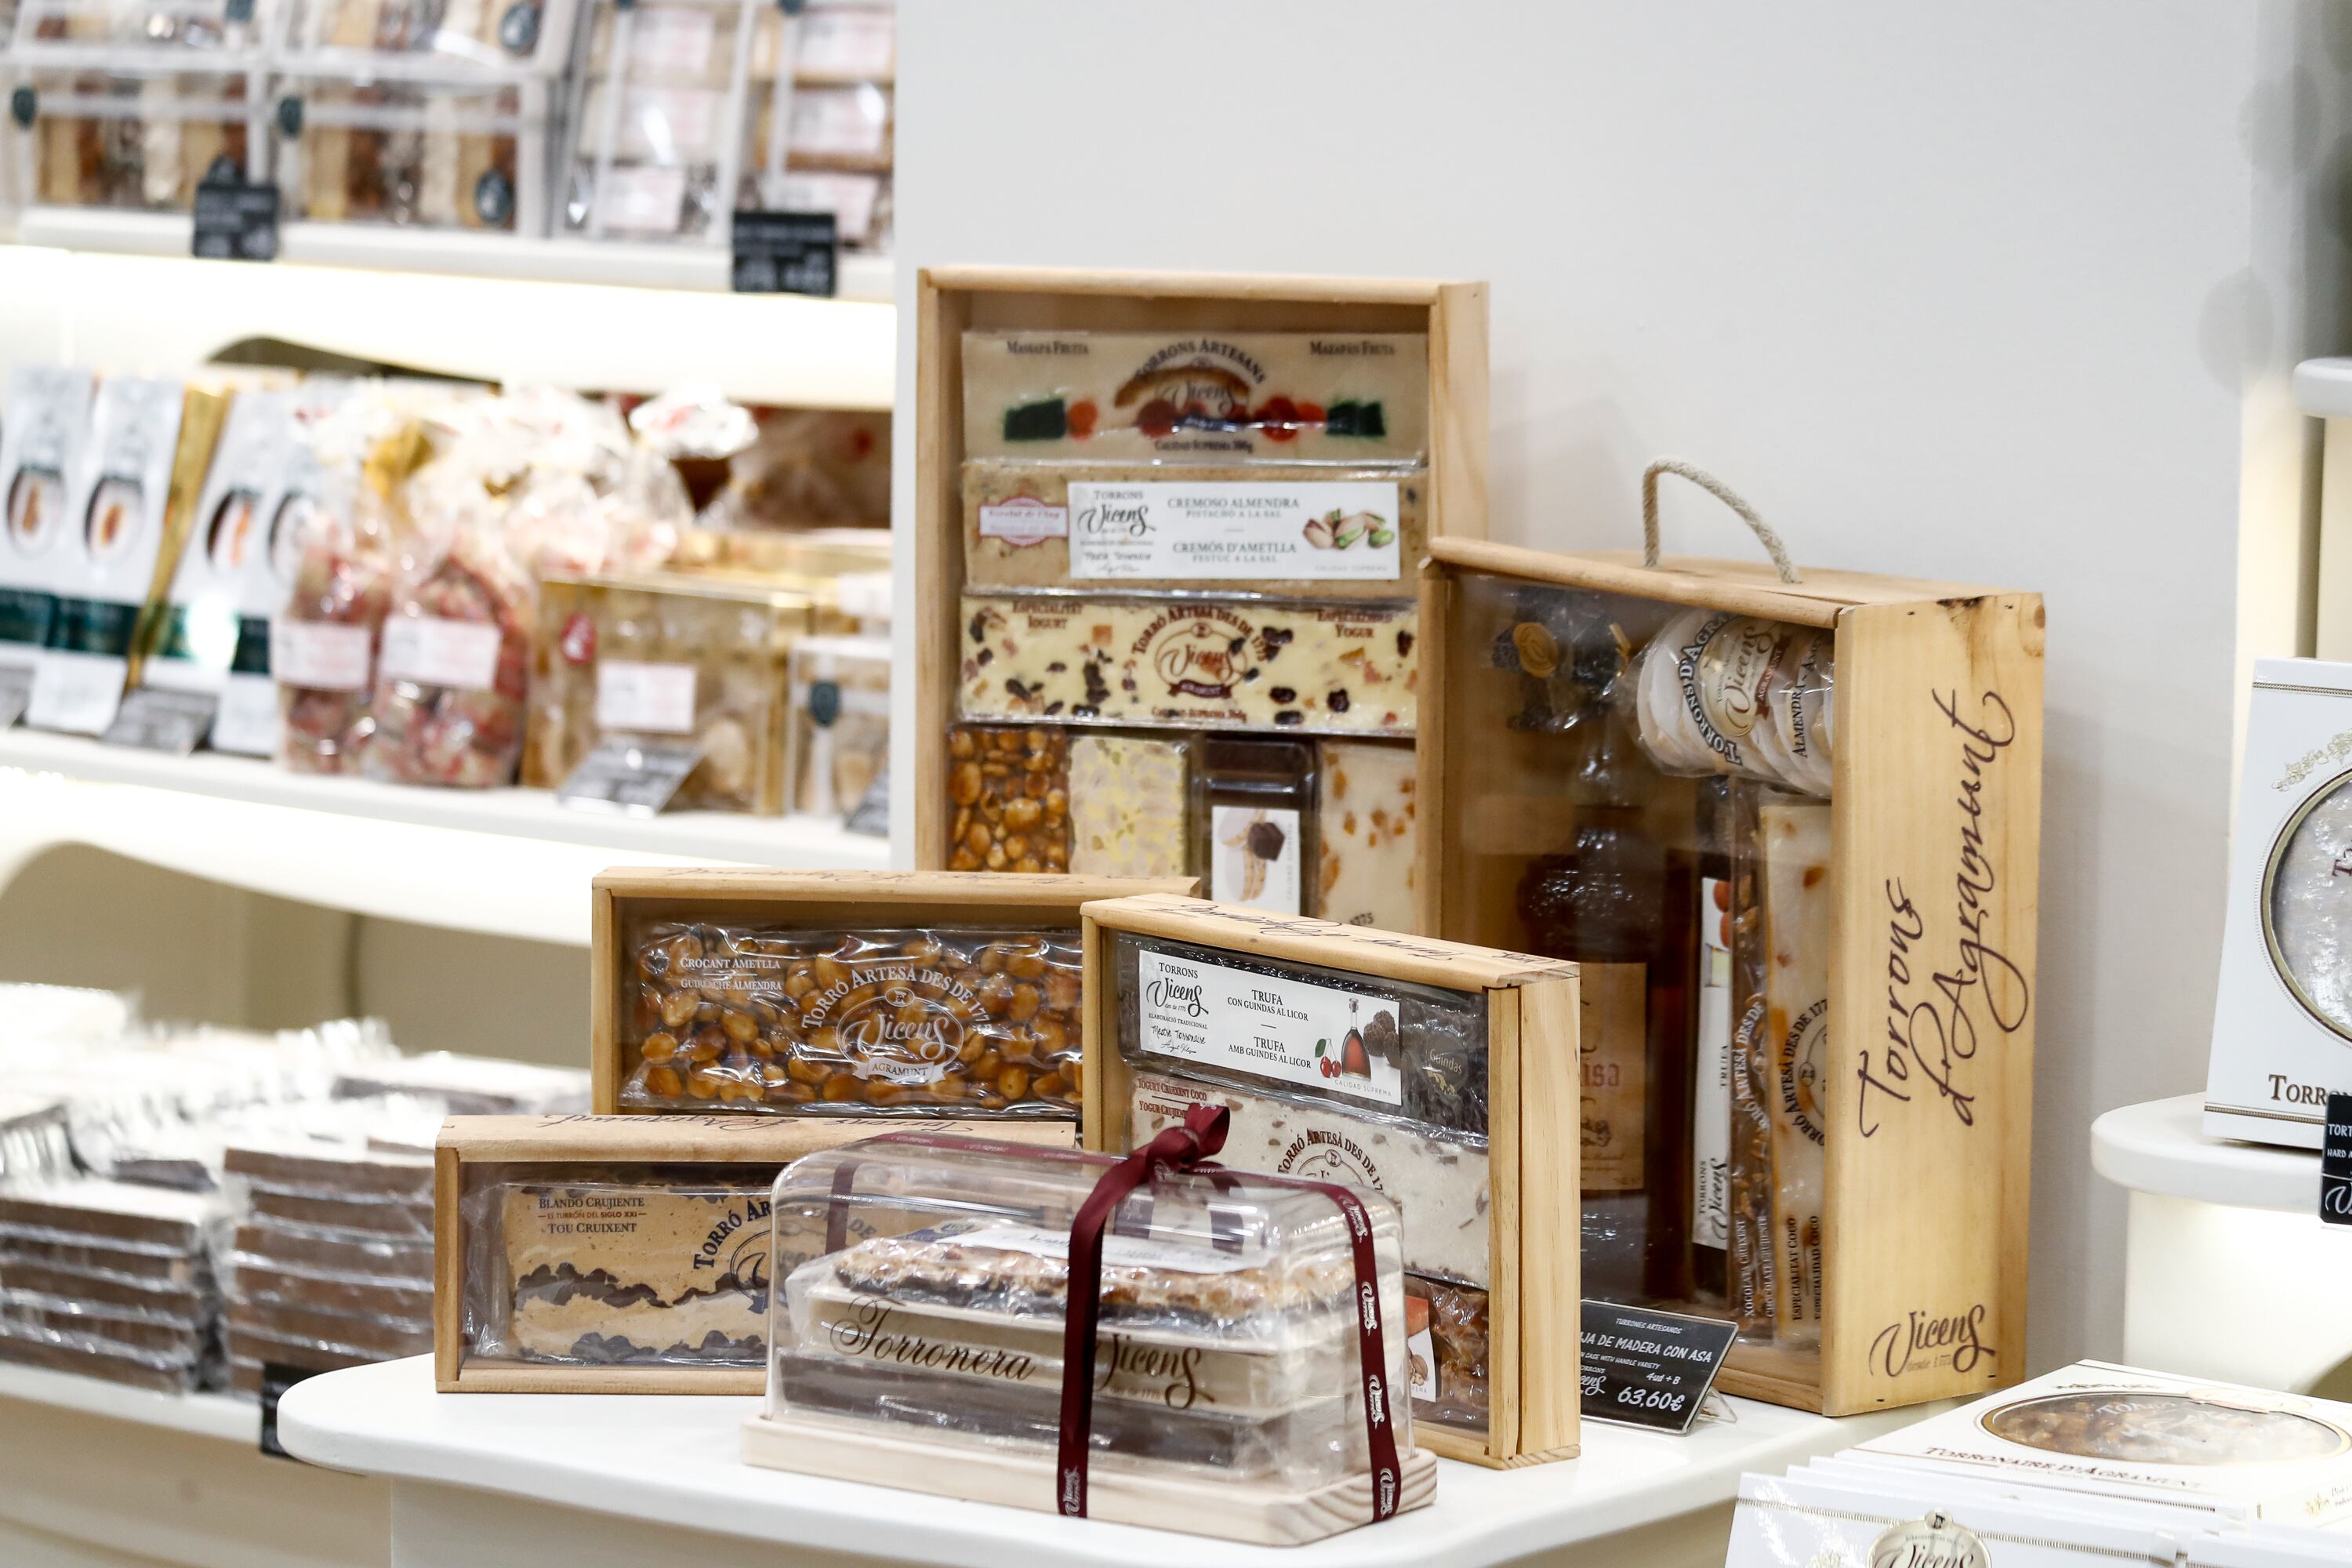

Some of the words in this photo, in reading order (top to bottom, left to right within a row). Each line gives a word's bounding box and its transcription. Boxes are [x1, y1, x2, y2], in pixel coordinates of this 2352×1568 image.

[1135, 340, 1196, 376] ORRONS
[1093, 491, 1144, 500] TORRONS
[1167, 499, 1229, 508] CREMOSO
[1230, 499, 1300, 508] ALMENDRA
[1078, 504, 1156, 537] Vicens
[1173, 541, 1225, 554] CREMÓS
[1227, 543, 1297, 553] D'AMETLLA
[1679, 612, 1730, 681] D'AGR
[1726, 624, 1778, 729] Vicens
[1683, 684, 1744, 766] TORRONS
[1791, 684, 1808, 758] ALMENDRA
[680, 957, 731, 970] CROCANT
[733, 958, 782, 969] AMETLLA
[1159, 962, 1199, 979] TORRONS
[732, 981, 782, 991] ALMENDRA
[801, 979, 850, 1029] TORRÓ
[851, 964, 916, 989] ARTESÀ
[920, 968, 953, 991] DES
[949, 982, 975, 1005] DE
[1145, 977, 1210, 1018] Vicens
[1251, 989, 1284, 1006] TRUFA
[1227, 996, 1243, 1007] CON
[1243, 1000, 1276, 1014] GUINDAS
[1276, 1007, 1287, 1017] AL
[1287, 1009, 1309, 1022] LICOR
[1809, 999, 1828, 1018] 177
[1859, 876, 1924, 1138] Torrons
[1149, 1012, 1177, 1024] ELABORACIÓ
[1177, 1018, 1209, 1030] TRADICIONAL
[1736, 1018, 1755, 1044] DES
[1795, 1013, 1812, 1032] DE
[841, 1013, 960, 1060] Vicens
[1254, 1036, 1286, 1053] TRUFA
[1784, 1032, 1801, 1057] DES
[1228, 1044, 1245, 1054] AMB
[1245, 1047, 1278, 1062] GUINDES
[1278, 1055, 1289, 1064] AL
[1289, 1056, 1312, 1069] LICOR
[1429, 1047, 1463, 1075] Guindas
[871, 1062, 929, 1078] AGRAMUNT
[1190, 1088, 1207, 1102] COCO
[1334, 1079, 1361, 1091] CALIDAD
[1363, 1085, 1392, 1098] SUPREMA
[1779, 1060, 1800, 1113] ARTESÀ
[1138, 1101, 1160, 1115] YOGUR
[1791, 1114, 1825, 1146] ORRÓ
[2328, 1123, 2352, 1137] TORT
[1277, 1133, 1305, 1174] TORRÓ
[1306, 1127, 1343, 1149] ARTESÀ
[1344, 1138, 1363, 1161] DES
[1362, 1155, 1376, 1177] DE
[1372, 1176, 1385, 1195] 17
[2327, 1149, 2347, 1158] HARD
[1698, 1160, 1708, 1214] TORRONS
[539, 1196, 583, 1209] BLANDO
[586, 1196, 644, 1209] CRUJIENTE
[557, 1210, 586, 1219] TURRÓN
[548, 1223, 574, 1234] TOU
[576, 1222, 637, 1234] CRUIXENT
[693, 1210, 742, 1270] TORRÓ
[1788, 1218, 1797, 1248] COCO
[829, 1294, 1036, 1381] Torronera
[1615, 1318, 1646, 1329] TURRONES
[1646, 1323, 1683, 1334] ARTESANOS
[1581, 1331, 1595, 1345] JA
[1597, 1334, 1615, 1348] DE
[1615, 1338, 1661, 1356] MADERA
[1663, 1345, 1689, 1359] CON
[1688, 1350, 1713, 1363] ASA
[1869, 1304, 1997, 1377] Vicens
[1581, 1364, 1606, 1374] ORRONS
[1585, 1352, 1600, 1361] CASE
[1615, 1357, 1637, 1367] HANDLE
[1637, 1360, 1661, 1370] VARIETY
[1646, 1372, 1664, 1382] 4ud
[1672, 1376, 1682, 1385] B
[1617, 1385, 1686, 1412] 63,60€
[1923, 1446, 2053, 1470] TORRONAIRE
